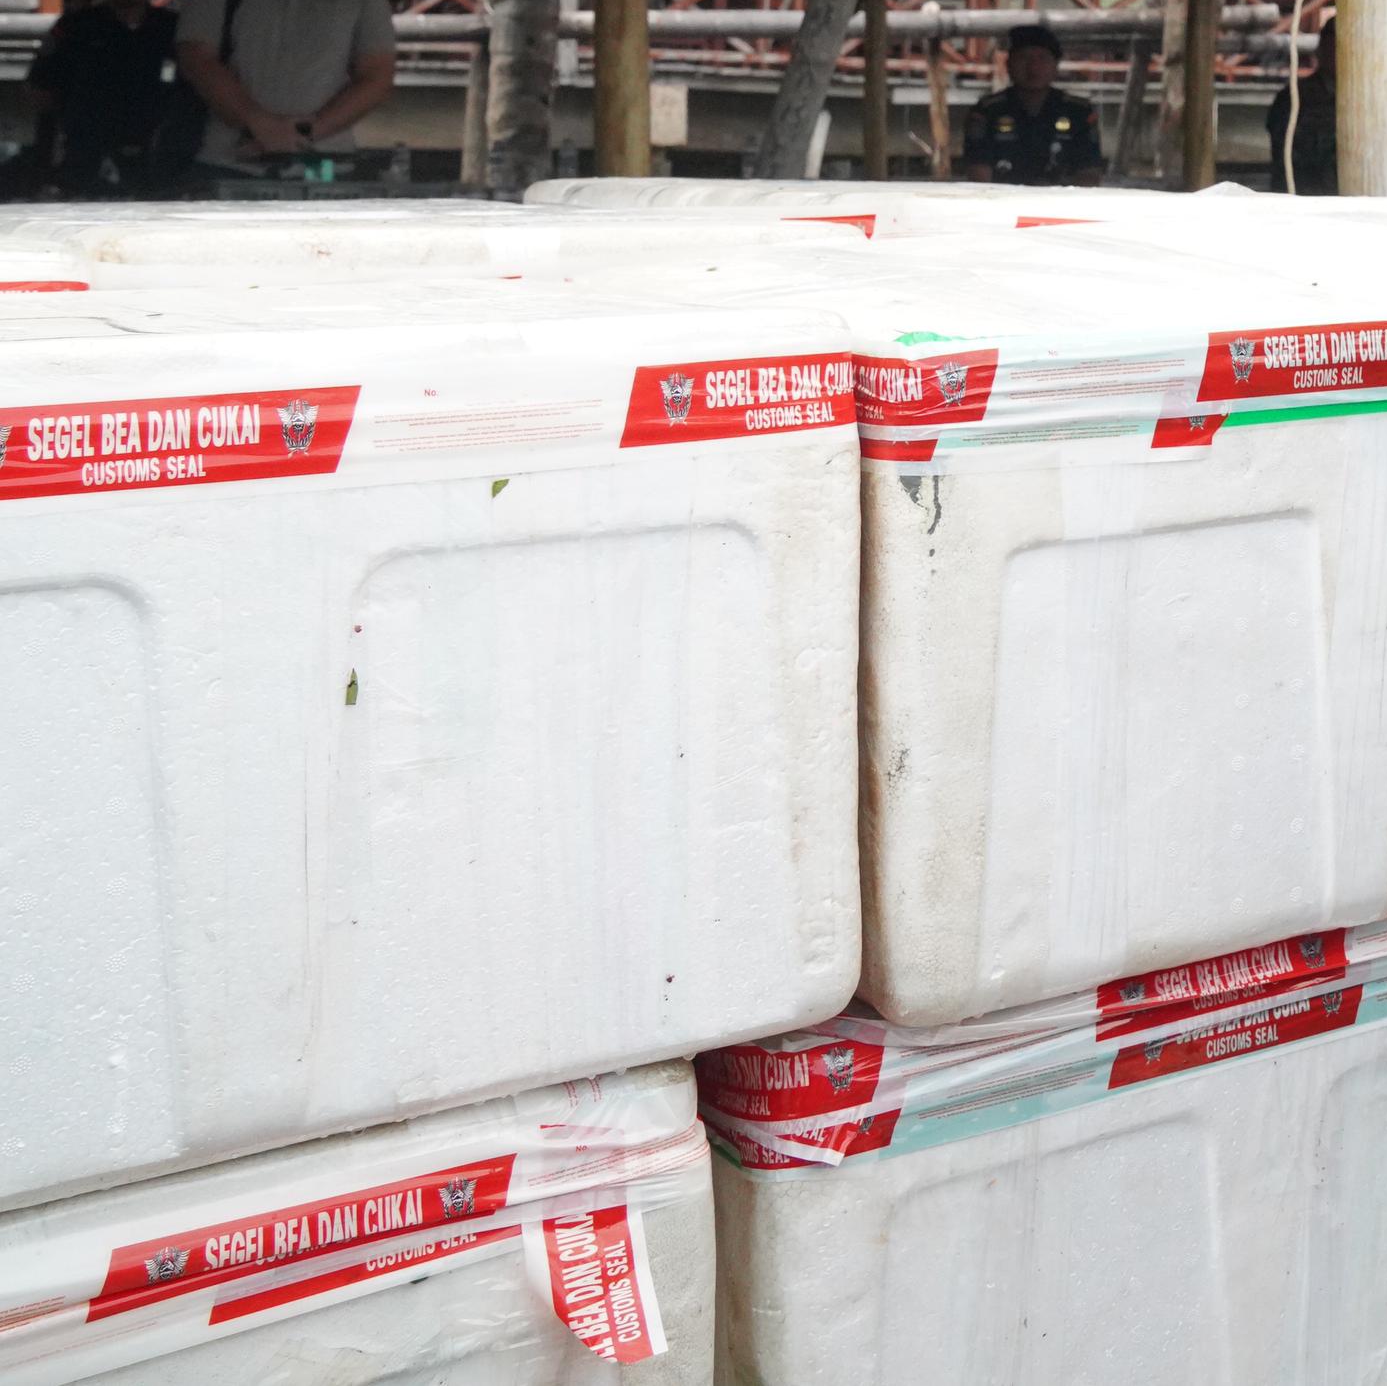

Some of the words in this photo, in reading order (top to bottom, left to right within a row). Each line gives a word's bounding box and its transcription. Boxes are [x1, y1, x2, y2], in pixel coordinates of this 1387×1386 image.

[1264, 332, 1302, 370] SEGEL
[1305, 332, 1329, 367] BEA
[1330, 330, 1357, 365] DAN
[705, 367, 755, 410] SEGEL
[758, 364, 788, 404] BEA
[791, 363, 822, 402] DAN
[879, 366, 923, 403] CUKAI
[1293, 369, 1338, 389] CUSTOMS
[1340, 366, 1364, 385] SEAL
[27, 414, 96, 462] SEGEL
[101, 411, 141, 456] BEA
[147, 407, 192, 452] DAN
[197, 404, 262, 448] CUKAI
[745, 405, 803, 430] CUSTOMS
[806, 401, 836, 423] SEAL
[81, 458, 162, 487] CUSTOMS
[167, 453, 207, 480] SEAL
[1154, 967, 1198, 1002] SEGEL
[1199, 960, 1223, 996] BEA
[1223, 952, 1251, 989] DAN
[1252, 942, 1294, 981] CUKAI
[1206, 1034, 1253, 1058] CUSTOMS
[1255, 1026, 1279, 1045] SEAL
[765, 1053, 810, 1091] CUKAI
[749, 1095, 771, 1116] SEAL
[204, 1226, 265, 1272] SEGEL
[274, 1216, 311, 1257] BEA
[317, 1203, 358, 1246] DAN
[364, 1188, 423, 1236] CUKAI
[366, 1244, 436, 1272] CUSTOMS
[603, 1239, 629, 1277] SEAL
[561, 1261, 603, 1305] DAN
[567, 1299, 611, 1340] BEA
[608, 1275, 642, 1343] CUSTOMS
